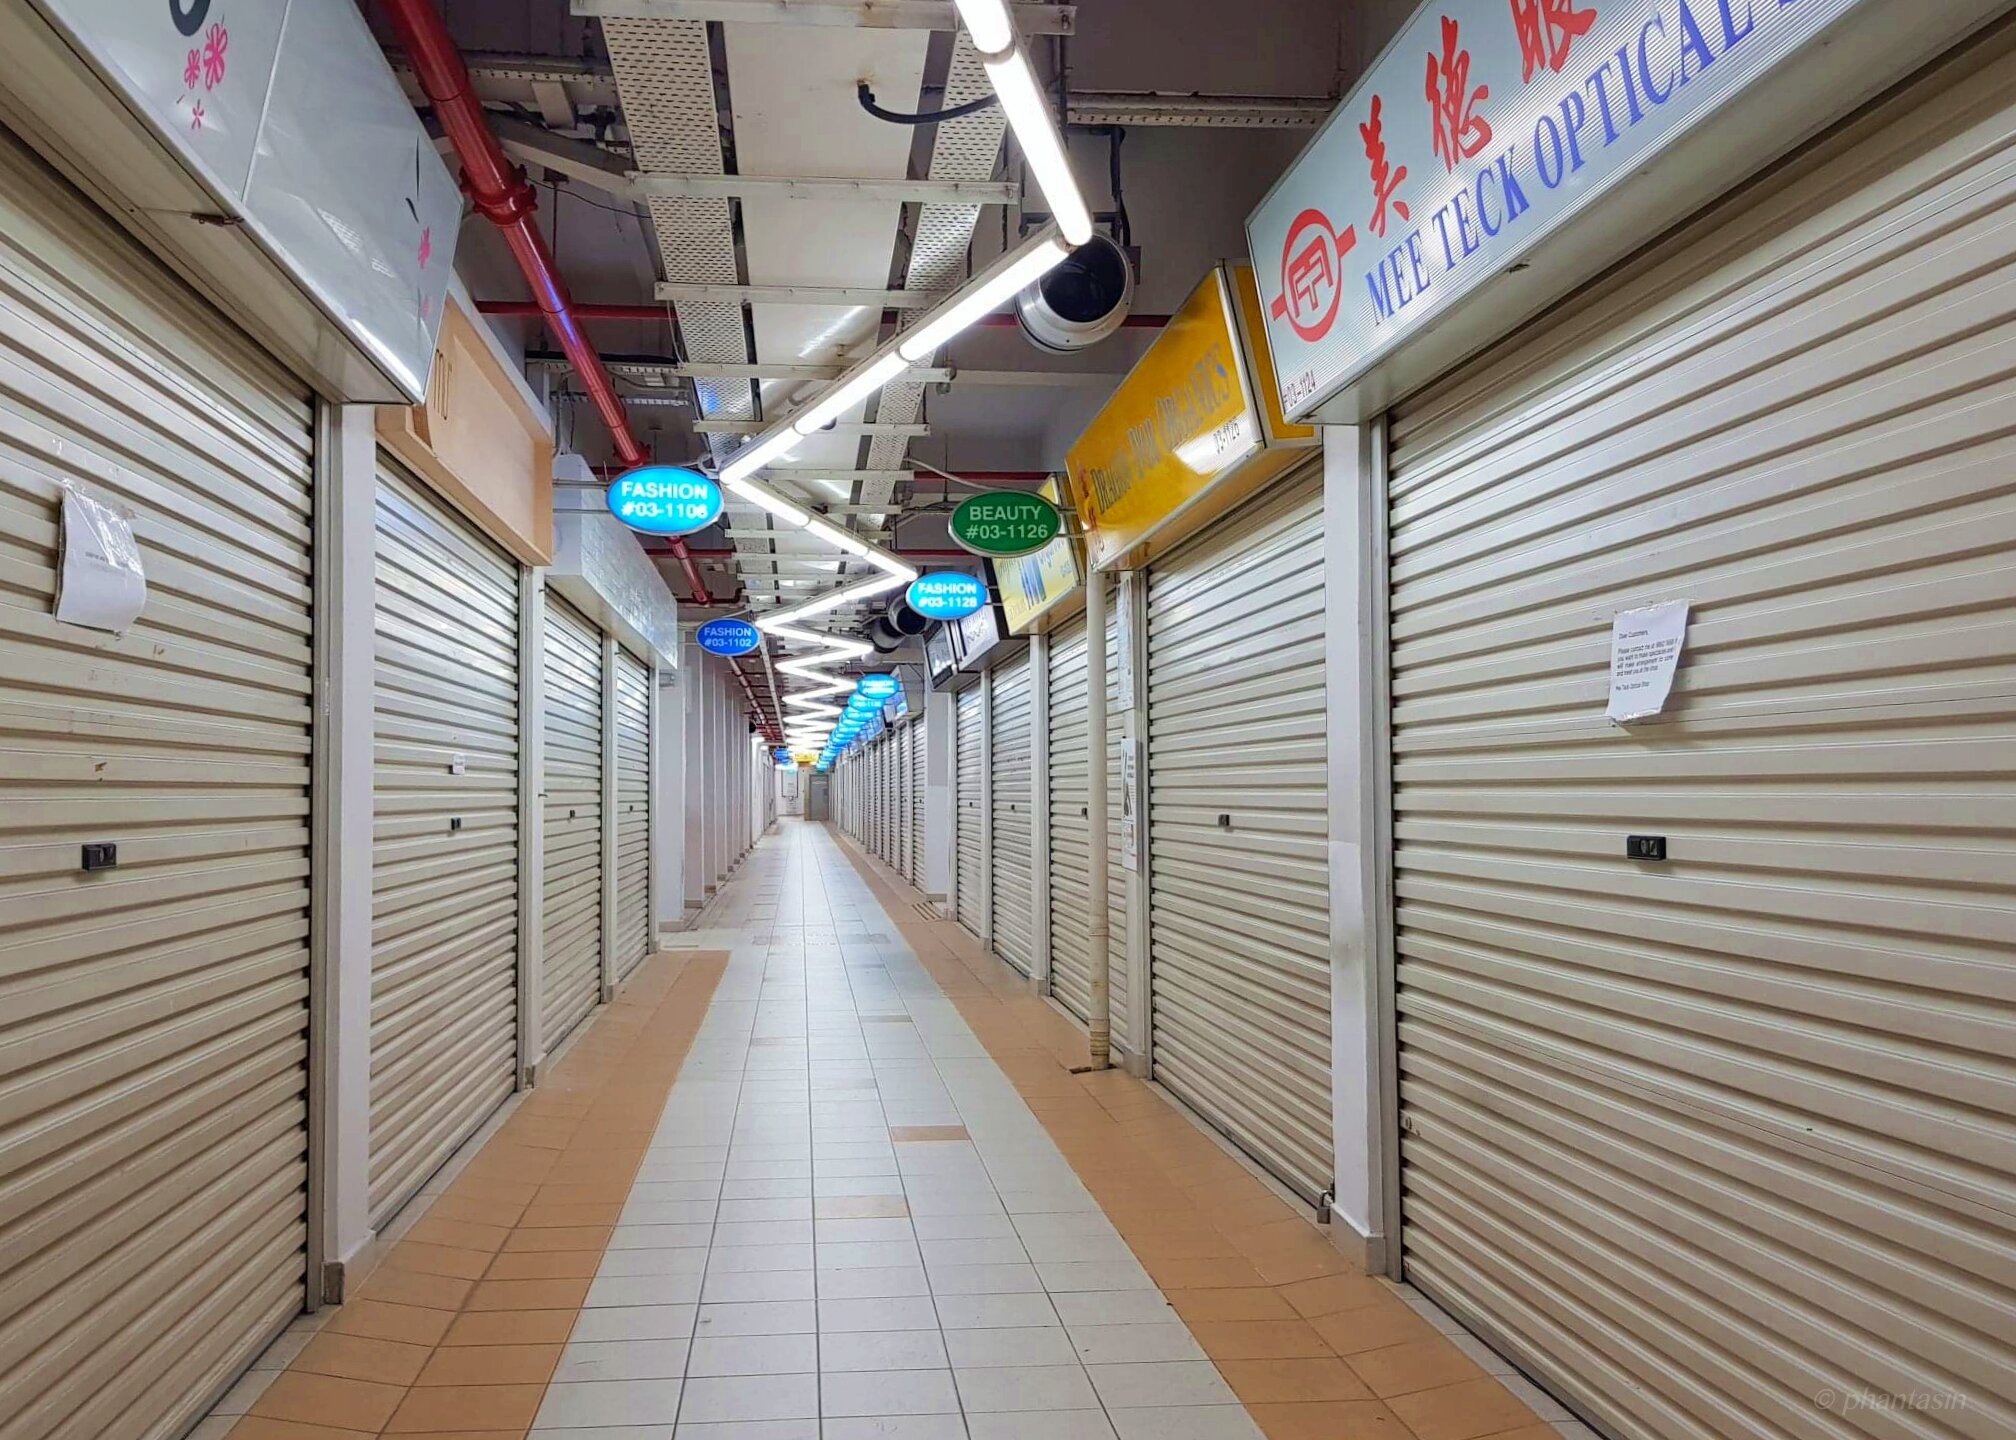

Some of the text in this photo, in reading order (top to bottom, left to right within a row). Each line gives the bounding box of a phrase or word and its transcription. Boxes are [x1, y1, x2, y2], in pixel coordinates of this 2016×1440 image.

[1365, 0, 1755, 327] MEE TECK OPTICAL
[621, 481, 708, 500] FASHION
[969, 506, 1042, 521] BEAUTY
[965, 524, 1048, 539] #03-1126
[917, 582, 977, 594] FASHION
[704, 627, 752, 637] FASHION
[704, 638, 752, 647] #03-1102
